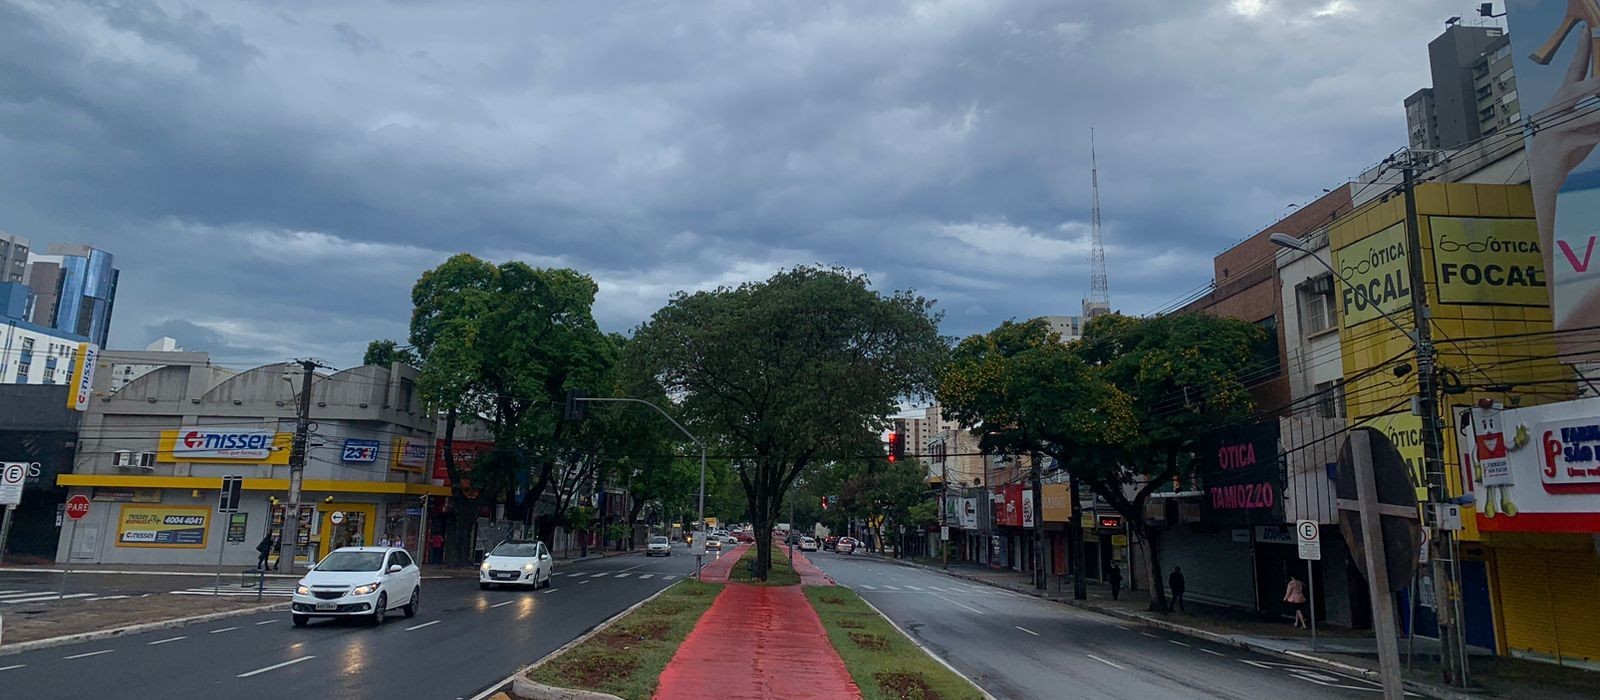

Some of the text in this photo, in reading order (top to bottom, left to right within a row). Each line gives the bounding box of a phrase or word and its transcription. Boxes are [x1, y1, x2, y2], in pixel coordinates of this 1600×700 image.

[1371, 242, 1405, 268] ÓTICA
[1490, 238, 1540, 253] ÓTICA
[1441, 263, 1546, 287] FOCAL
[1342, 269, 1410, 316] FOCAL
[205, 433, 268, 449] nissei
[1219, 440, 1256, 469] ÓTICA
[10, 469, 19, 479] E
[1210, 482, 1273, 509] TAMIOZZO
[67, 503, 89, 512] PARE
[1305, 525, 1312, 537] E
